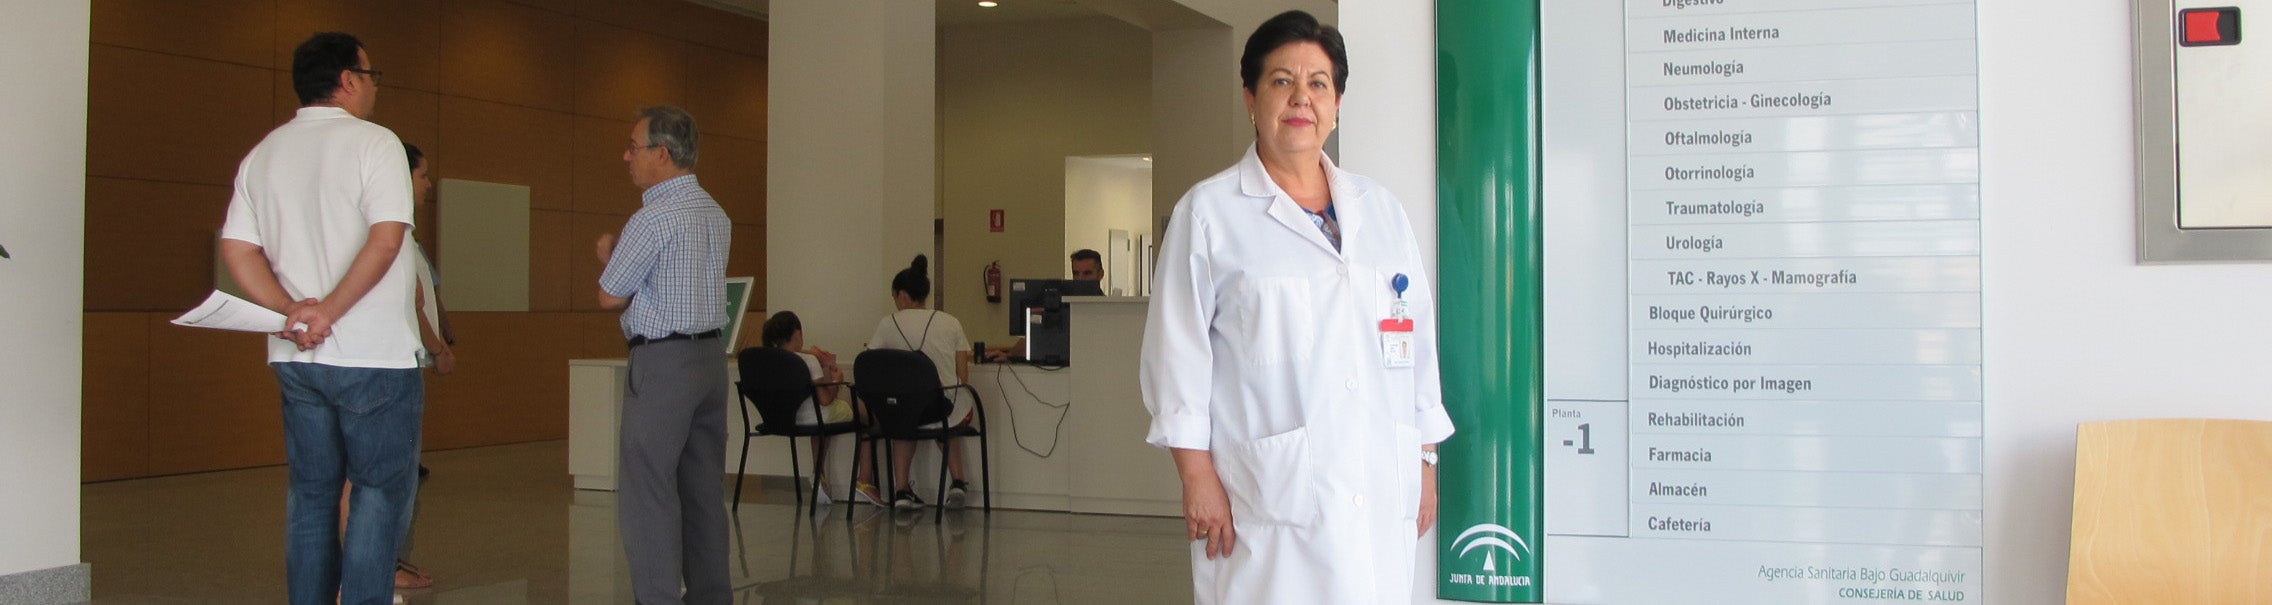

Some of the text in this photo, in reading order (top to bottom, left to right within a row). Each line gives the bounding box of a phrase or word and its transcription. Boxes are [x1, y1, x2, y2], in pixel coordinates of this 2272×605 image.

[1664, 26, 1780, 44] Medicina Interna
[1664, 60, 1744, 78] Neumología
[1664, 95, 1739, 112] Obstetricia
[1751, 91, 1832, 110] Ginecología
[1665, 130, 1753, 148] Oftalmología
[1665, 164, 1755, 182] Otorrinología
[1666, 200, 1764, 218] Traumatología
[1666, 235, 1723, 253] Urología
[1668, 271, 1695, 286] TAC
[1706, 270, 1747, 289] Rayos
[1751, 270, 1760, 285] X
[1771, 269, 1857, 288] Mamografía
[1649, 305, 1773, 324] Bloque Quirúrgico
[1648, 341, 1752, 359] Hospitalización
[1649, 375, 1812, 394] Diagnóstico por Imagen
[1552, 408, 1581, 419] Planta
[1648, 412, 1745, 428] Rehabilitación
[1562, 423, 1595, 455] -1
[1649, 447, 1712, 463] Farmacia
[1649, 481, 1707, 497] Almacén
[1648, 515, 1711, 532] Cafetería
[1449, 573, 1472, 585] JUNTA
[1476, 575, 1485, 585] DE
[1758, 565, 1966, 586] Agencia Sanitaria Bajo Guadalquivir
[1839, 586, 1965, 602] CONSEJERÍA DE SALUD
